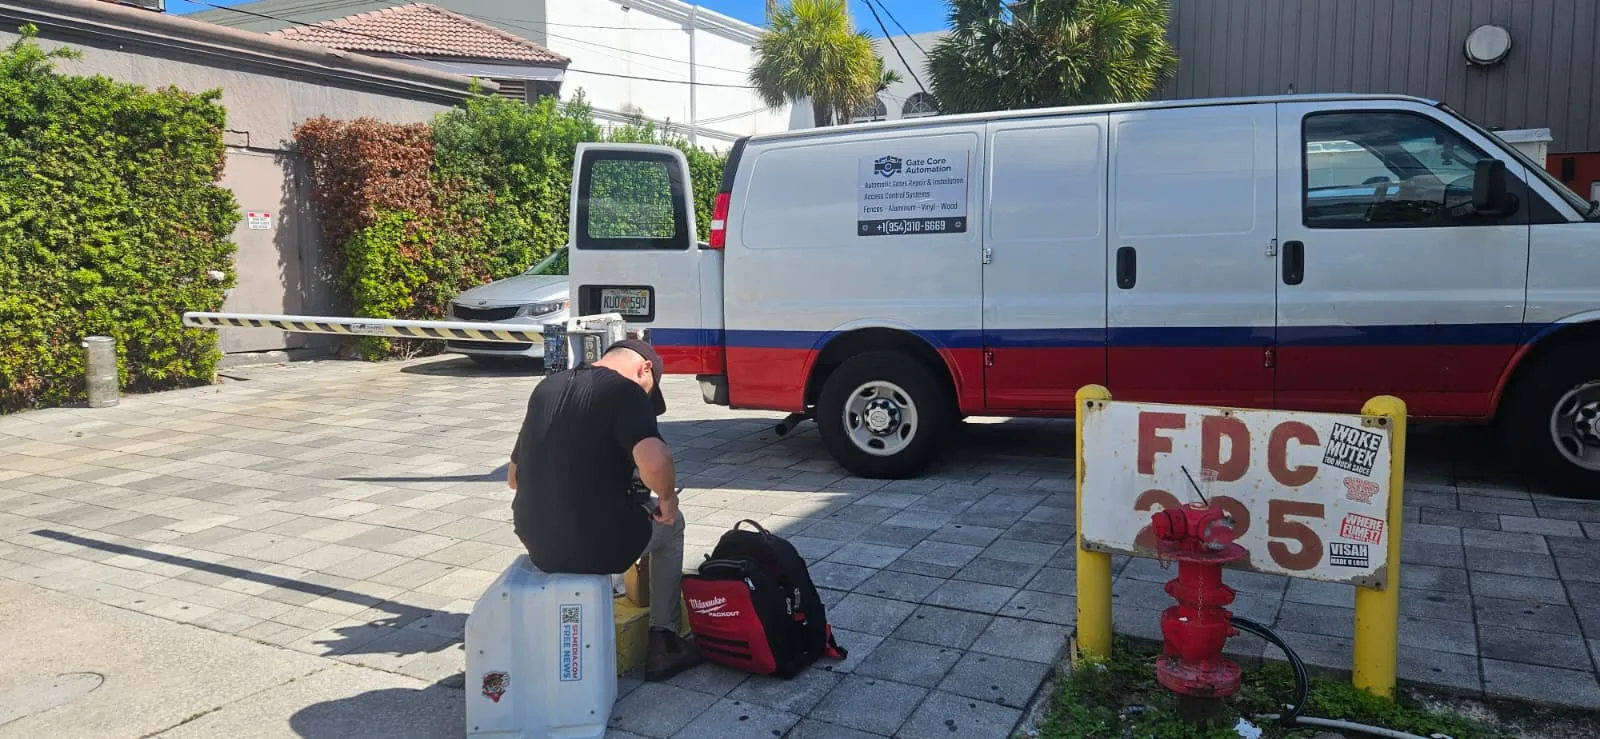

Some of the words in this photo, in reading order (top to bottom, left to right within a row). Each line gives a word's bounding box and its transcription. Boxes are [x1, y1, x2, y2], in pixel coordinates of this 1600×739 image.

[906, 159, 925, 167] Gate
[906, 165, 952, 174] Automation
[885, 192, 904, 200] Control
[906, 191, 930, 199] Systems
[864, 206, 884, 214] Fences
[888, 204, 916, 212] Aluminum
[921, 203, 936, 212] Vinyl
[940, 202, 958, 210] Wood
[876, 220, 946, 234] +1(954)310-6669
[1333, 424, 1381, 451] WOKE
[1137, 411, 1321, 487] FDC
[1326, 440, 1376, 468] MUTEK
[1324, 456, 1335, 464] TOO
[1335, 460, 1352, 470] MUCH
[1352, 464, 1372, 476] SAUCE
[1346, 514, 1383, 531] WHERE
[1330, 544, 1368, 557] VISAH
[688, 596, 727, 610] Milwaukee
[708, 610, 740, 618] PACKOUT
[563, 624, 571, 648] FREE
[563, 651, 571, 678] NEWS
